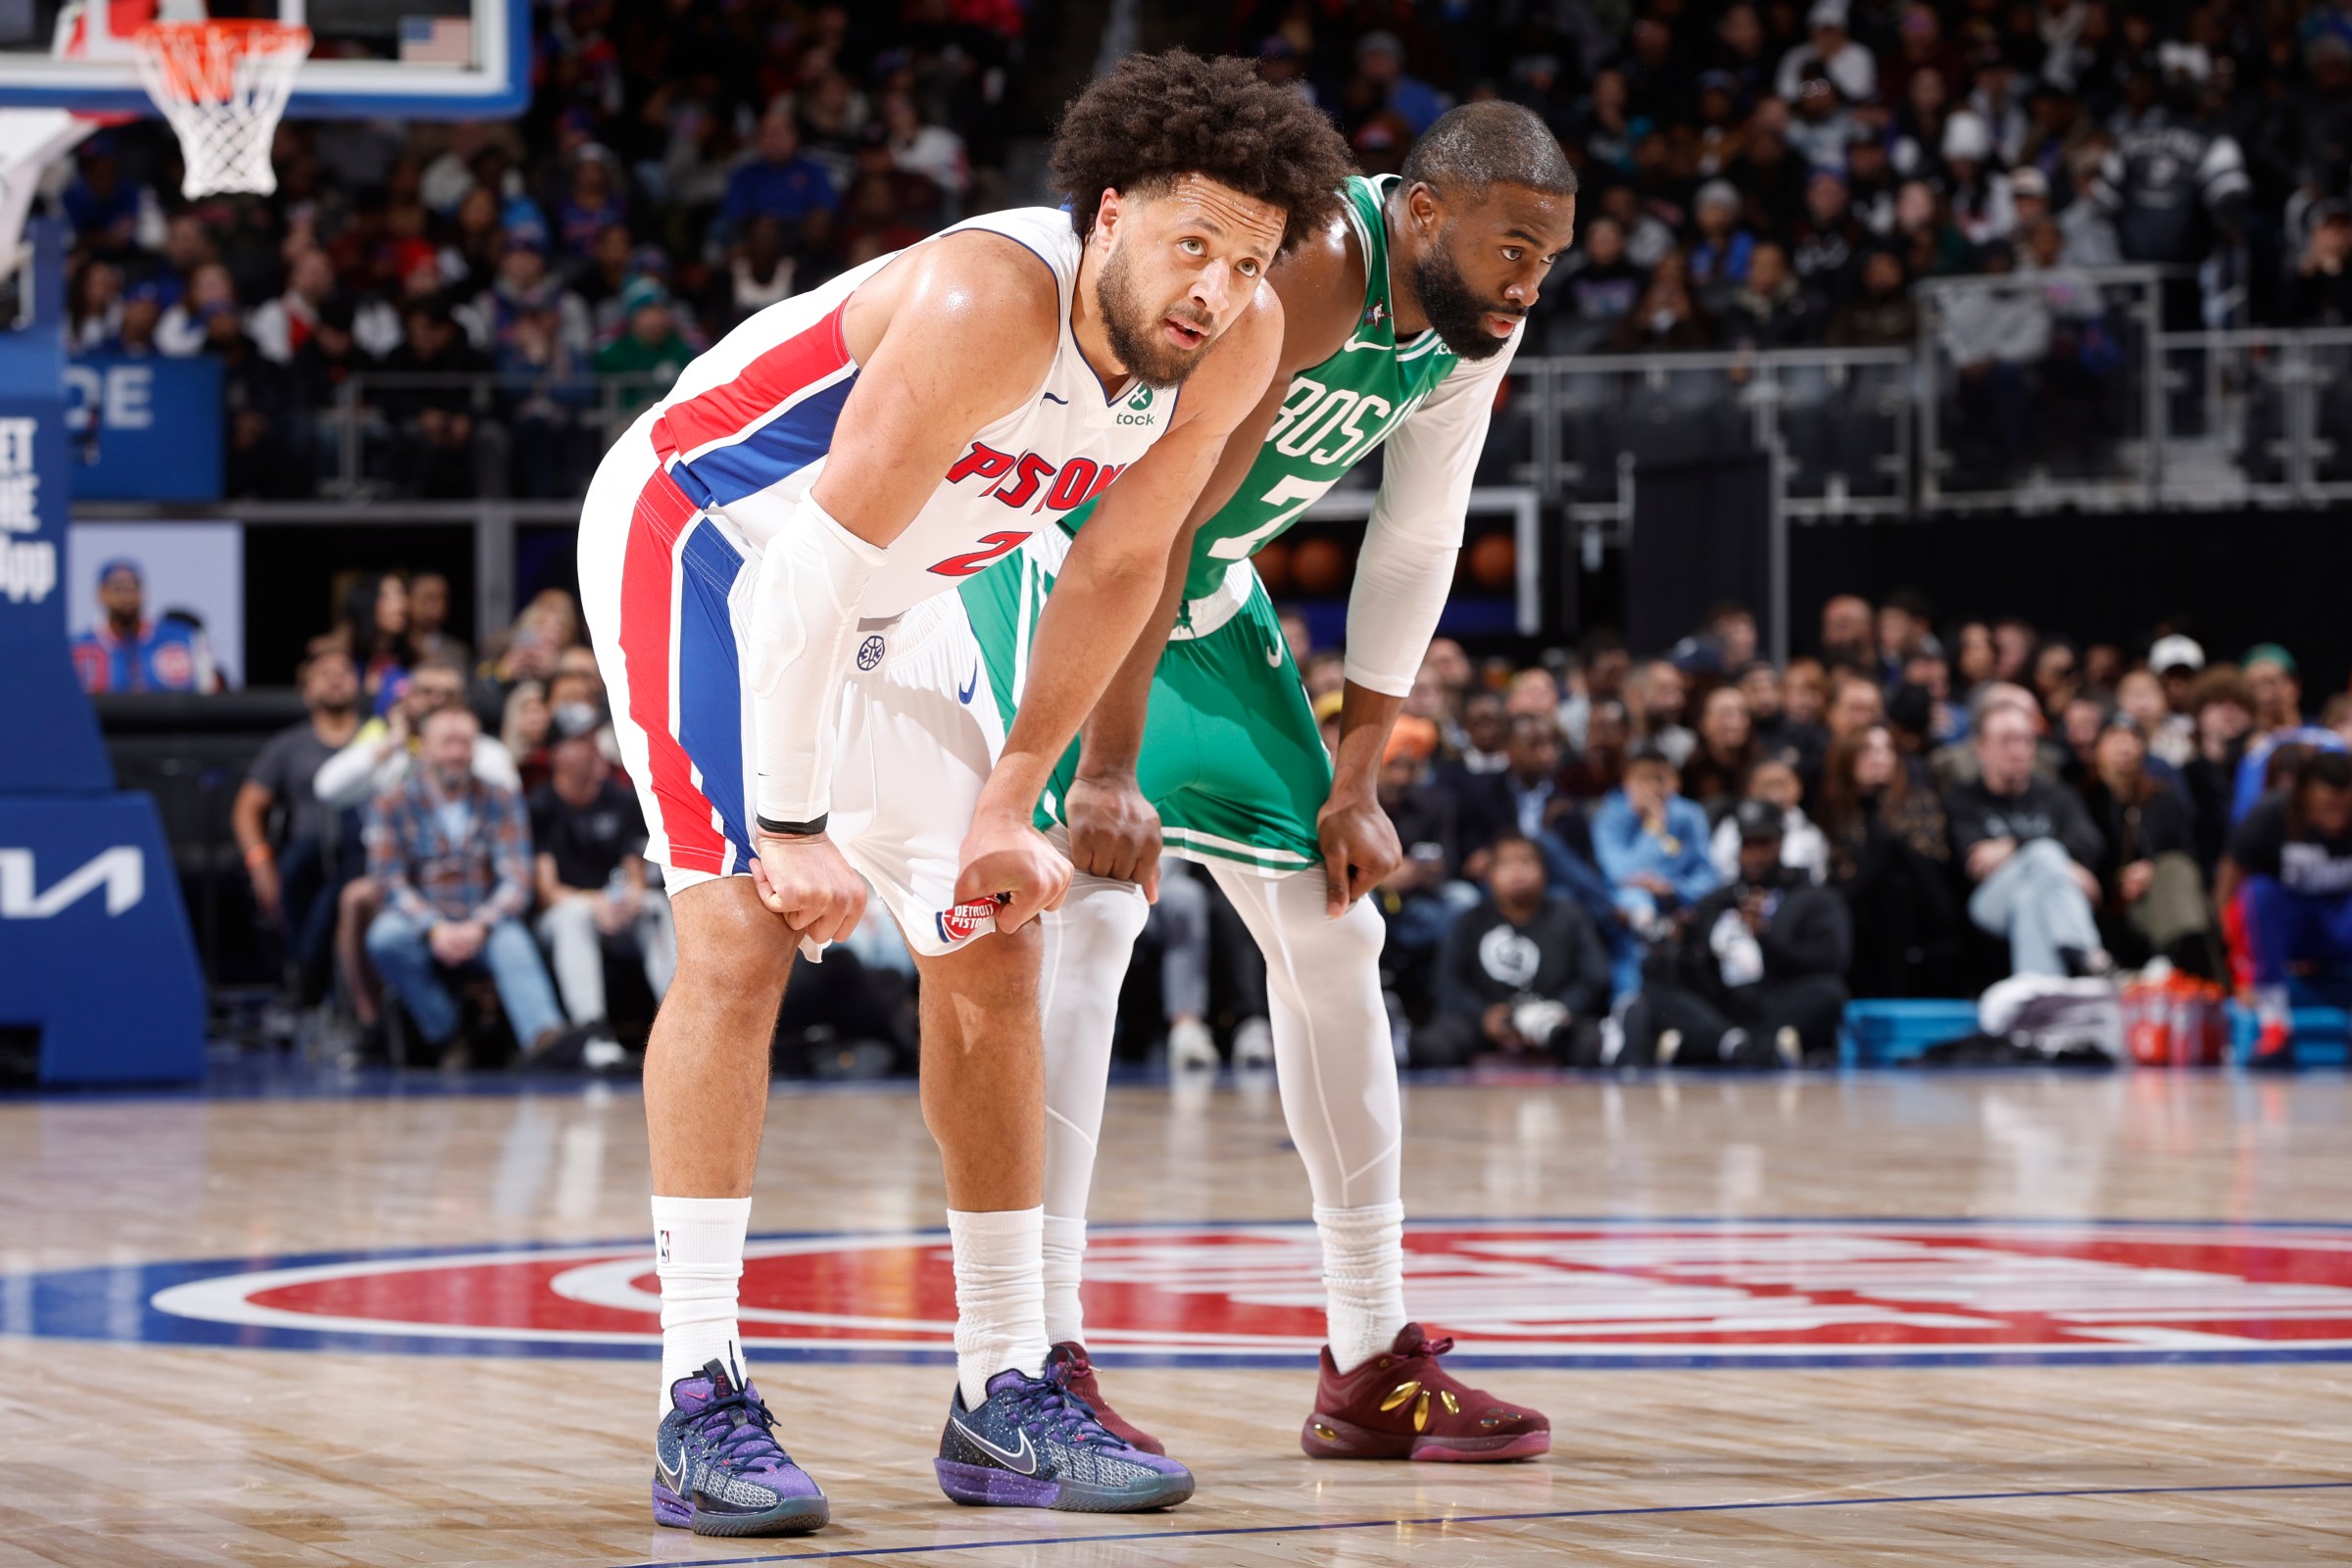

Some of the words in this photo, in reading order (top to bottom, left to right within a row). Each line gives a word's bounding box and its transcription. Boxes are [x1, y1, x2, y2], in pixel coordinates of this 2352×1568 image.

[1207, 474, 1341, 560] 7
[926, 531, 1032, 576] 2
[951, 916, 988, 929] PISTO
[955, 904, 994, 917] DETROIT
